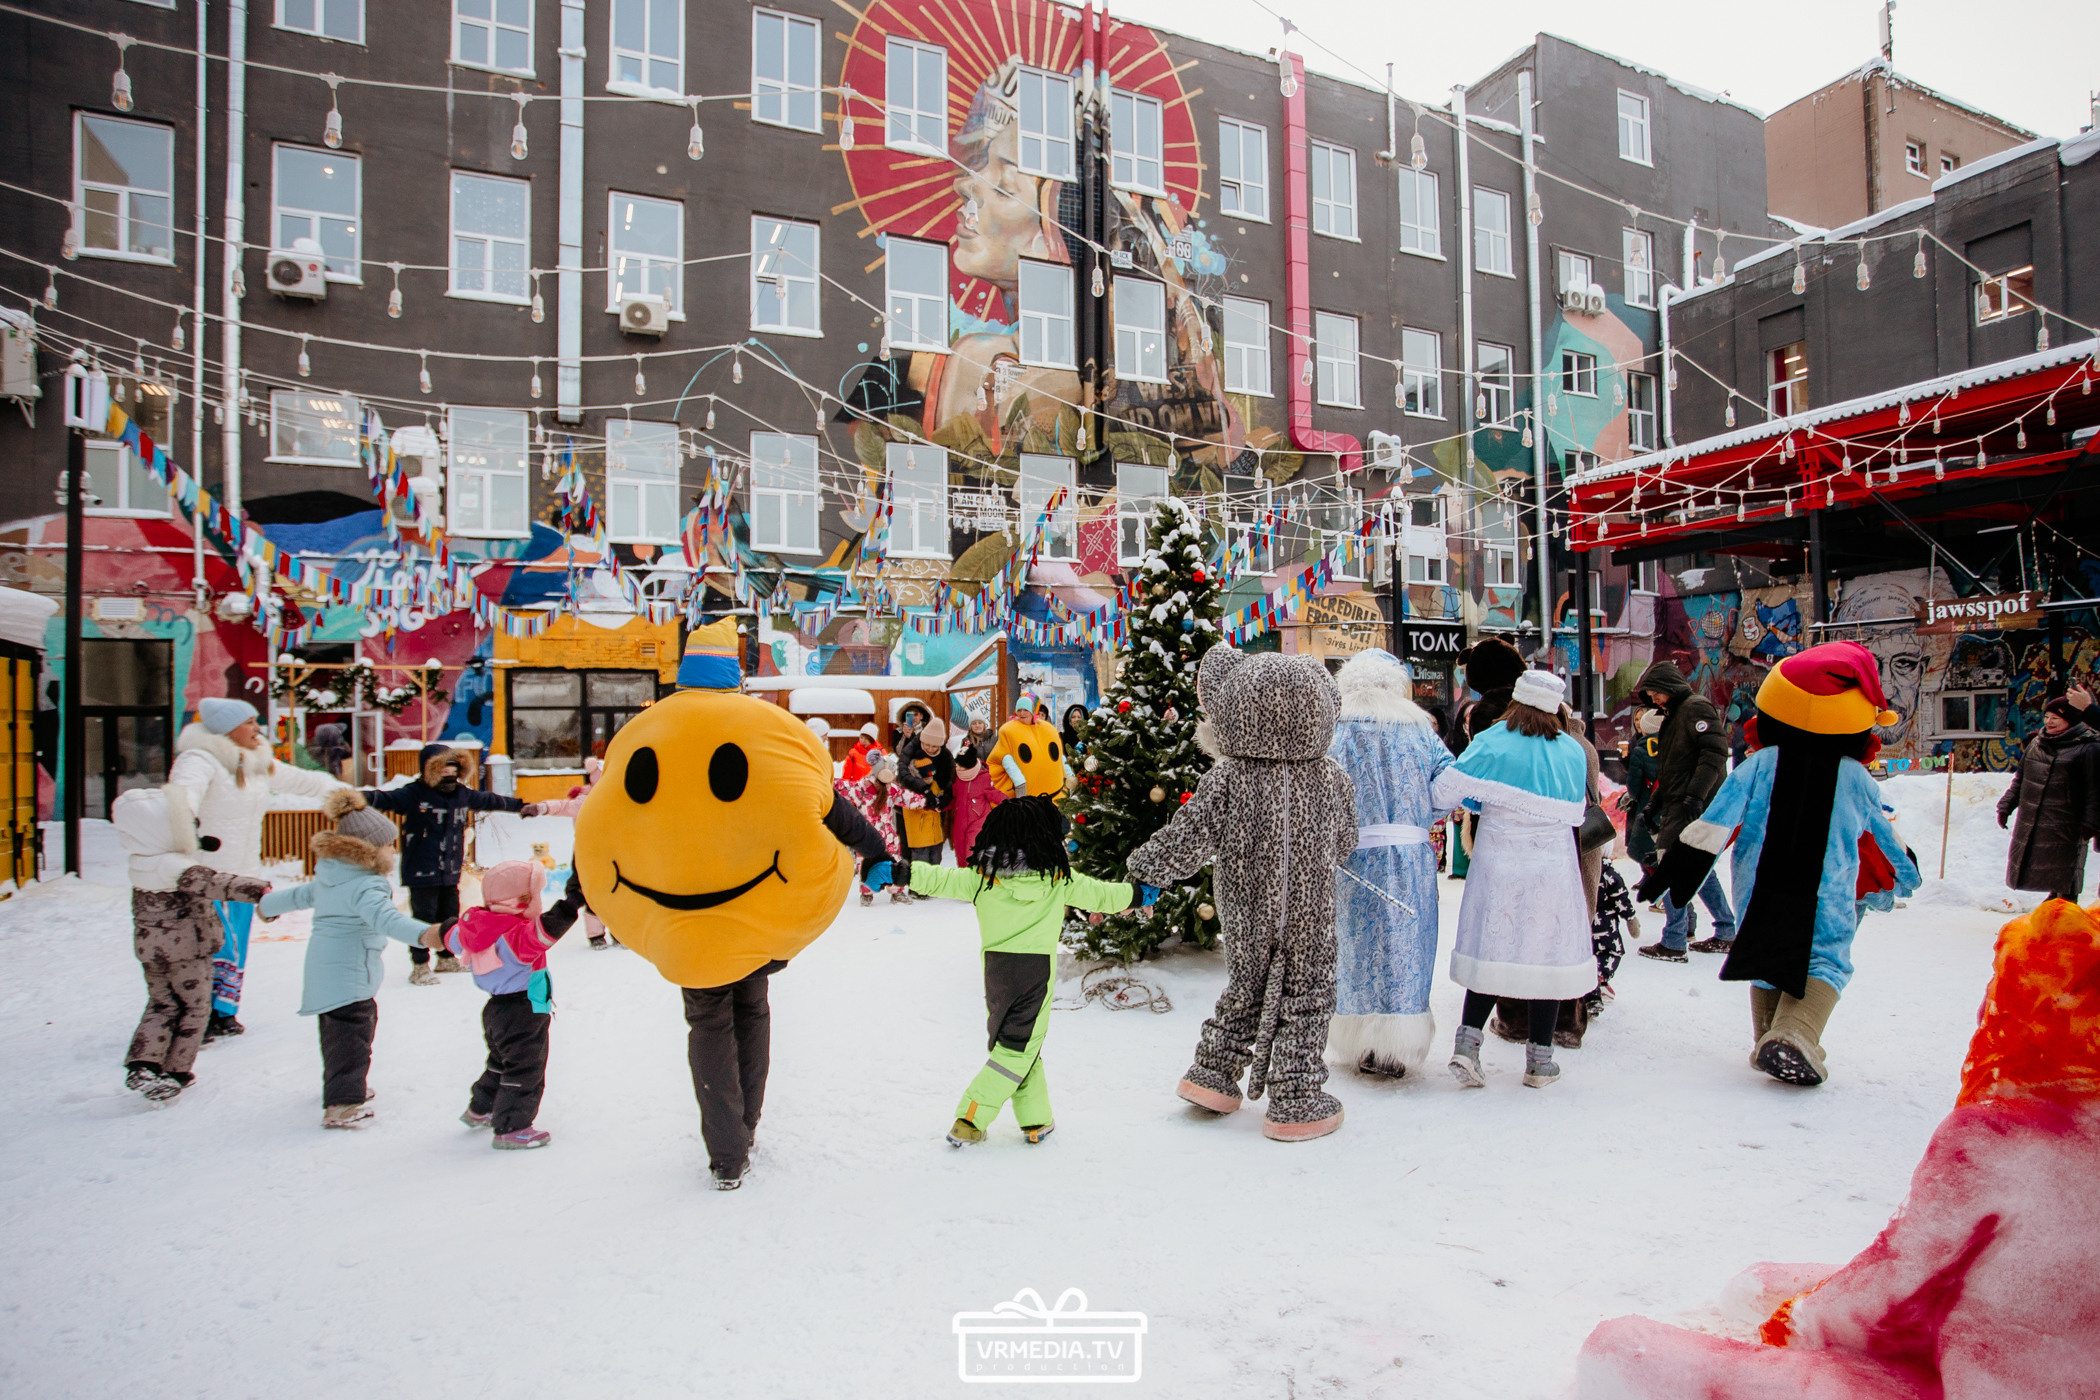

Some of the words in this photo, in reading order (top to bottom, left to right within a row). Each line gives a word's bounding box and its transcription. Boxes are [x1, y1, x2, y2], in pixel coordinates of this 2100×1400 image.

[979, 507, 1005, 518] MOON
[1926, 592, 2031, 625] jawsspot
[966, 696, 985, 712] WHO
